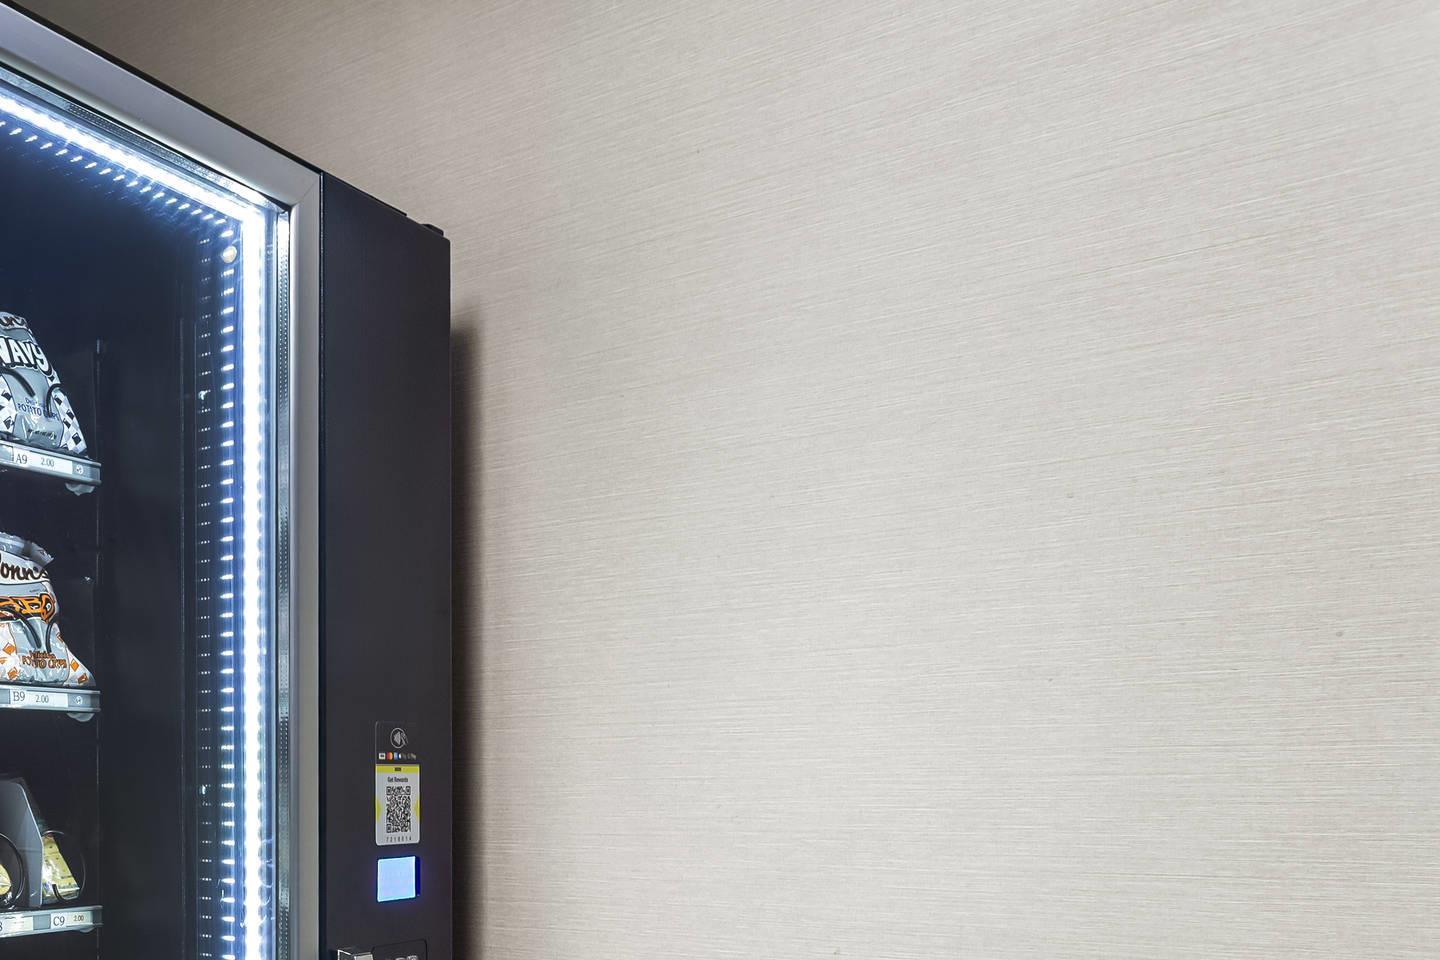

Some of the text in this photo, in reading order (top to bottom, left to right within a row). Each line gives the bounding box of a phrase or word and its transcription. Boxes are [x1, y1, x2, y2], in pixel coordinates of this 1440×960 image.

[15, 452, 55, 468] A9 2.00
[12, 690, 50, 704] B9 2.00
[53, 913, 85, 928] C9 2.00
